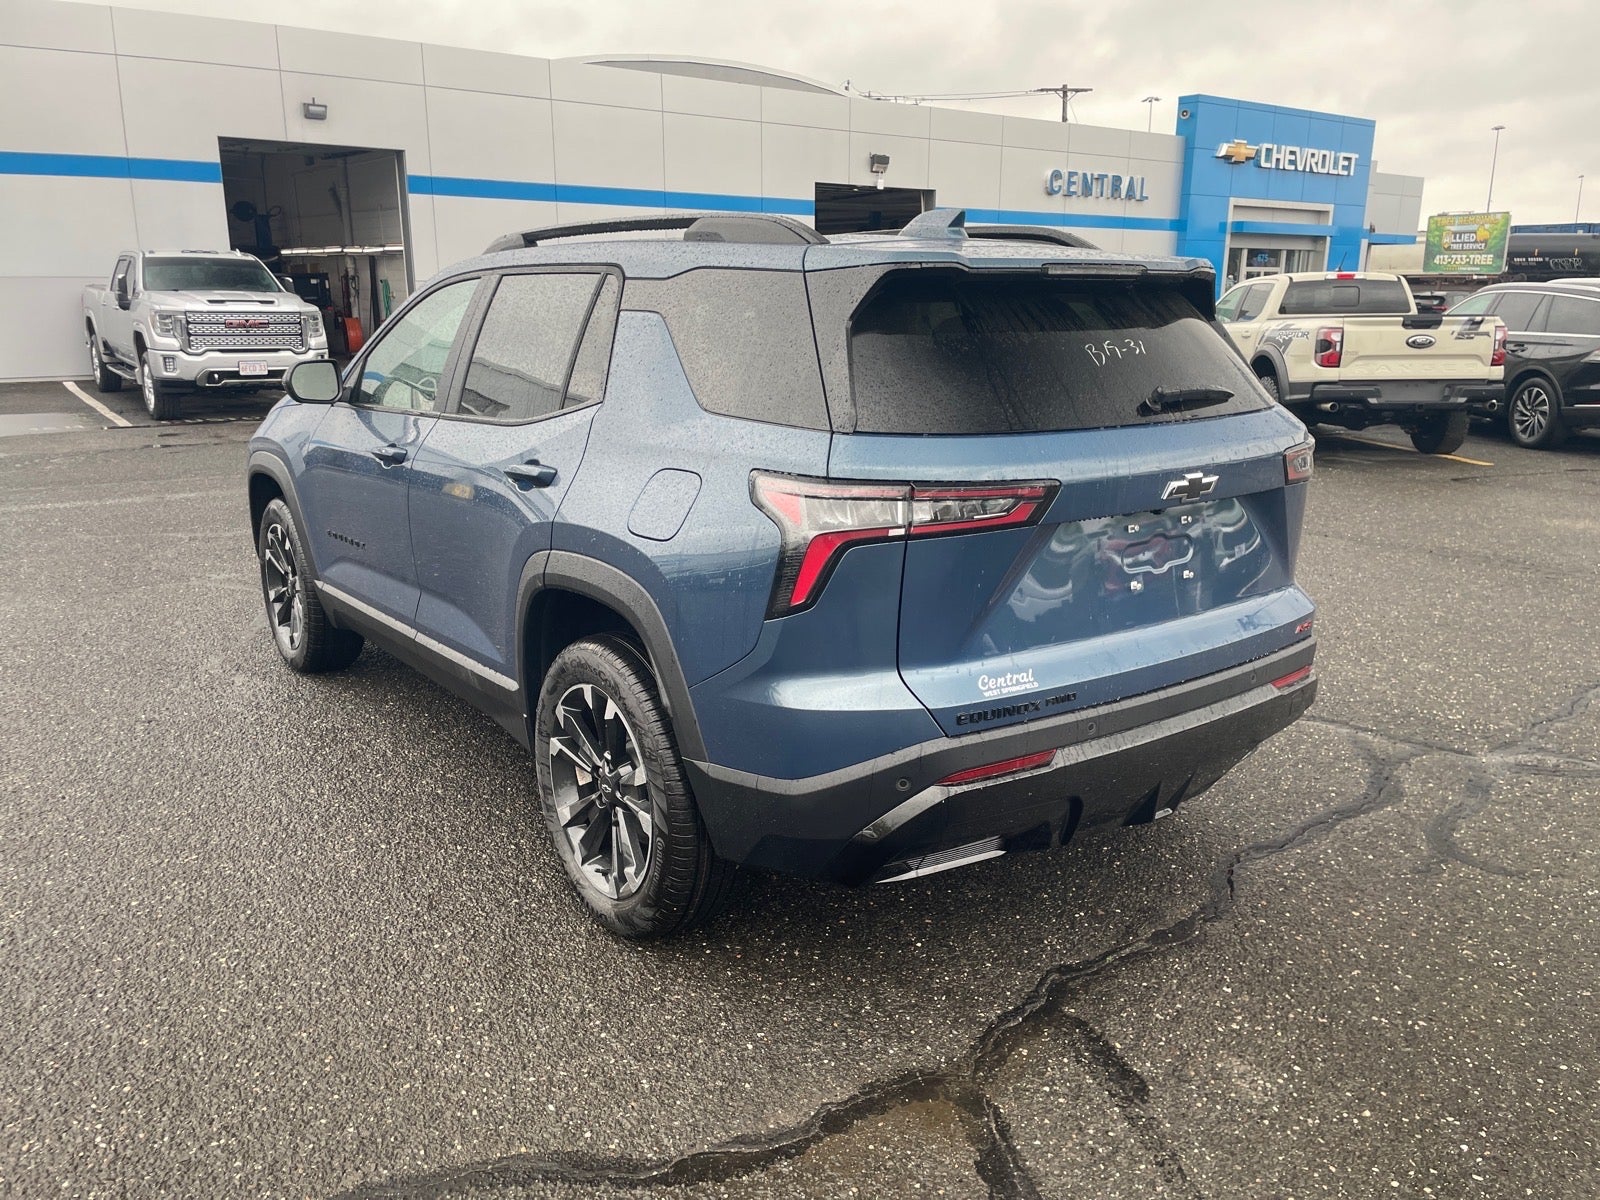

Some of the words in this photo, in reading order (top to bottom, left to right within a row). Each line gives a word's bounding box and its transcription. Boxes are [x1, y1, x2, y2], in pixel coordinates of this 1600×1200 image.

[1258, 143, 1359, 176] CHEVROLET
[1045, 169, 1149, 201] CENTRAL
[1443, 232, 1476, 243] ALLIED
[1463, 242, 1485, 250] SERVICE
[225, 319, 269, 328] GMC
[1277, 330, 1310, 342] RAPTOR
[978, 668, 1034, 690] Central
[983, 688, 1001, 698] WEST
[1001, 682, 1039, 694] SPRINGFIELD
[956, 700, 1041, 726] EQUINOX
[1045, 691, 1077, 707] AWD
